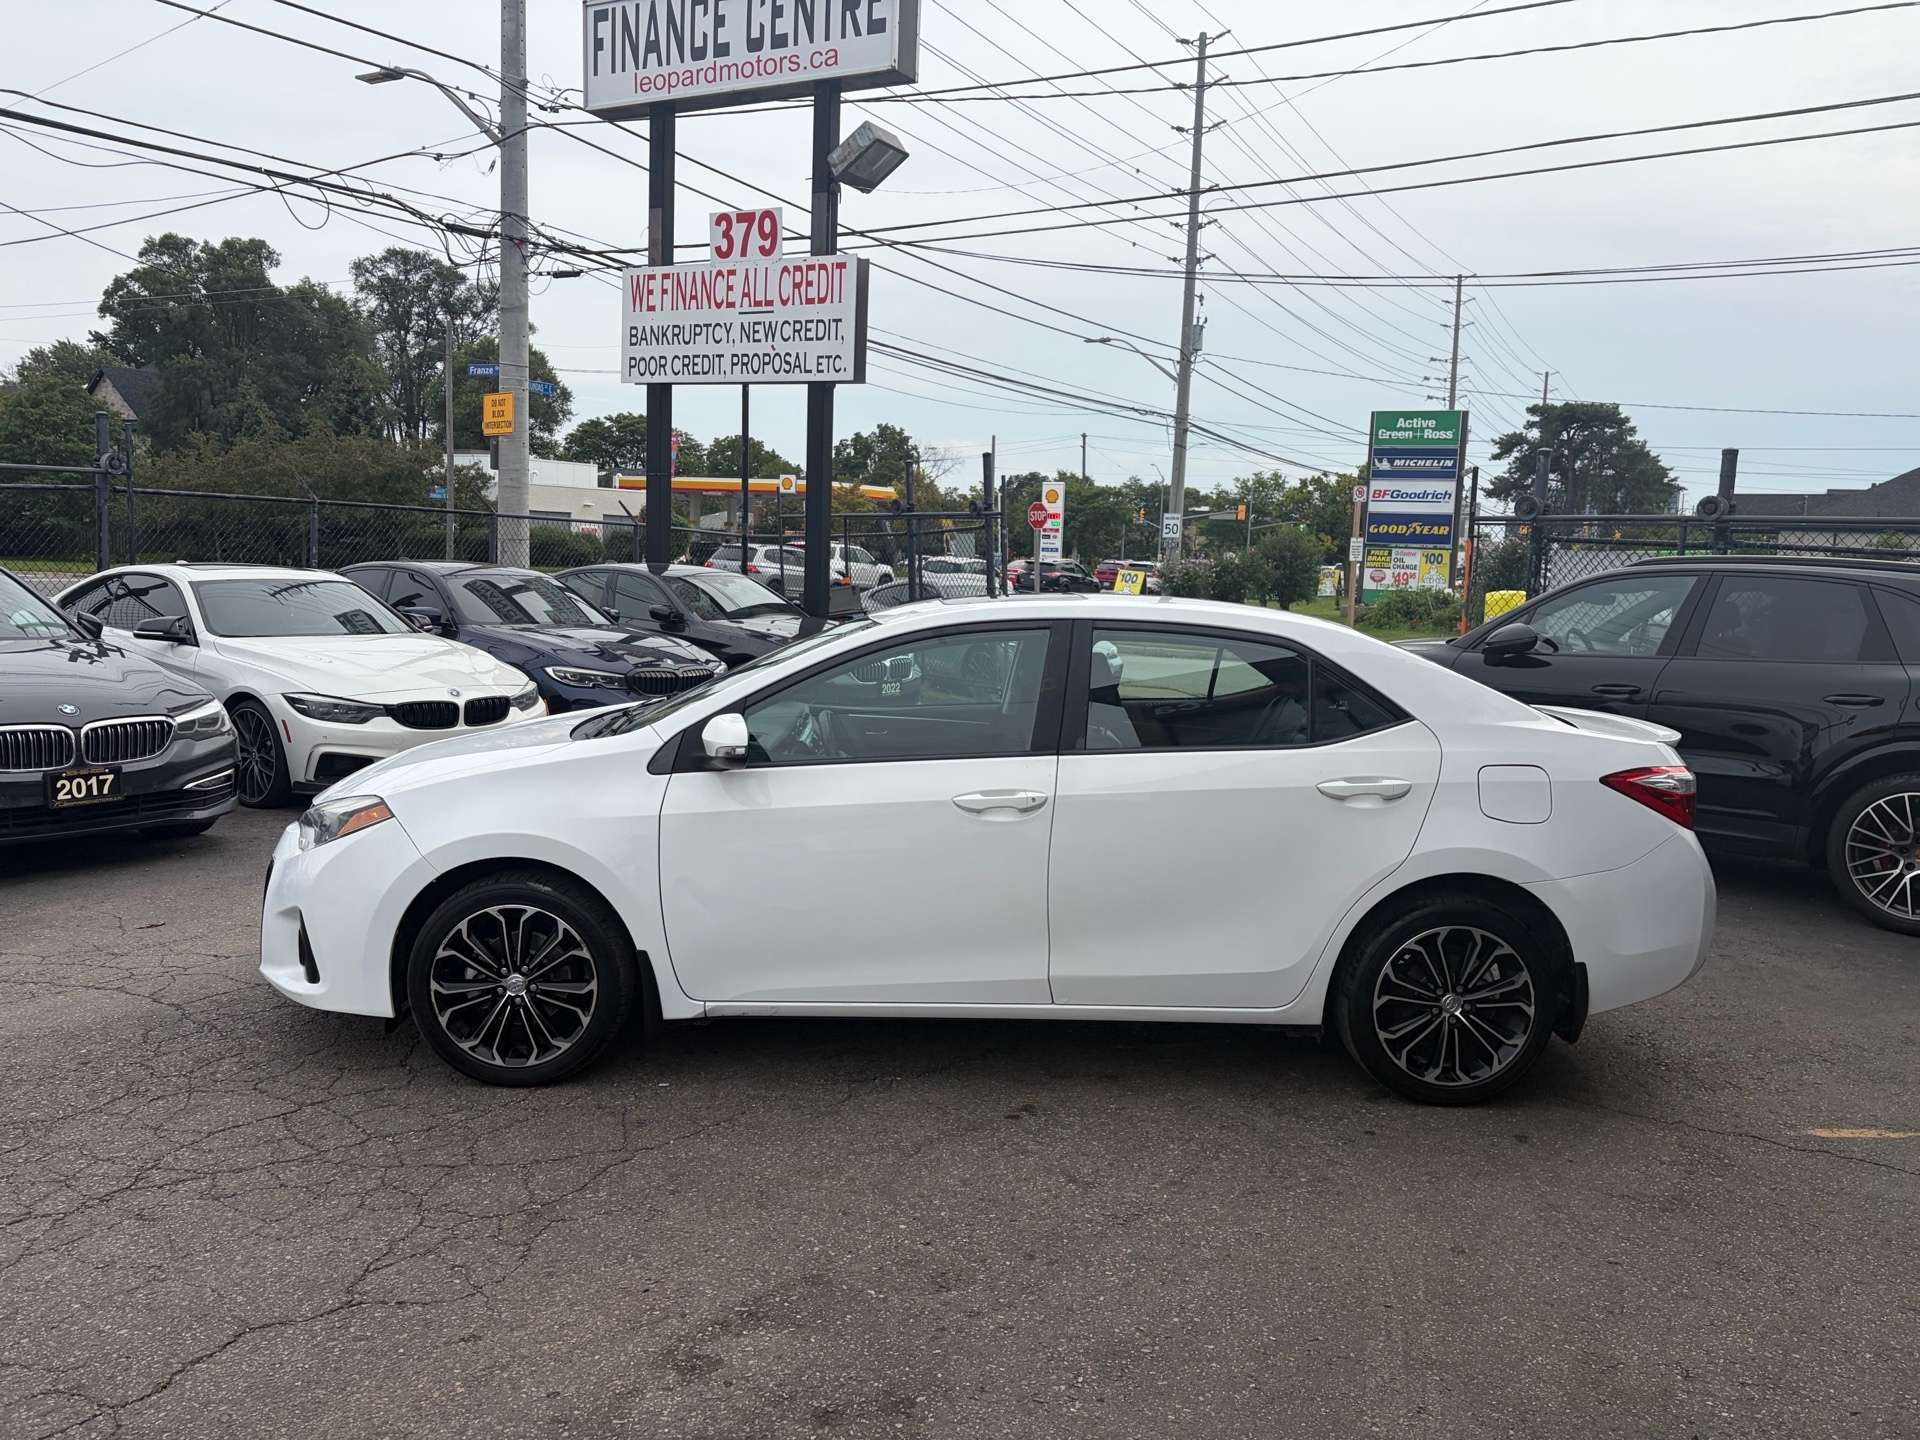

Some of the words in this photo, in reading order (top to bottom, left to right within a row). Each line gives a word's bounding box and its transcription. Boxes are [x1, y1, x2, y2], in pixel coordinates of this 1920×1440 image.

[593, 0, 730, 76] FINANCE
[634, 48, 839, 94] leopardmotors.ca
[714, 209, 778, 259] 379
[630, 273, 656, 312] WE
[661, 269, 736, 311] FINANCE
[739, 267, 774, 308] ALL
[779, 262, 847, 306] CREDIT
[629, 322, 735, 347] BANKRUPTCY,
[740, 321, 778, 343] NEW
[469, 366, 494, 375] Franze
[629, 355, 667, 377] POOR
[671, 353, 727, 379] CREDIT,
[816, 355, 847, 374] ETC.
[1396, 418, 1436, 428] Active
[1393, 459, 1454, 467] MICHELIN
[1372, 489, 1452, 500] BFGoodrich
[1030, 511, 1046, 521] STOP
[1165, 523, 1179, 535] 50
[1369, 522, 1449, 535] GOODYEAR
[882, 682, 901, 694] 2022
[56, 774, 114, 800] 2017
